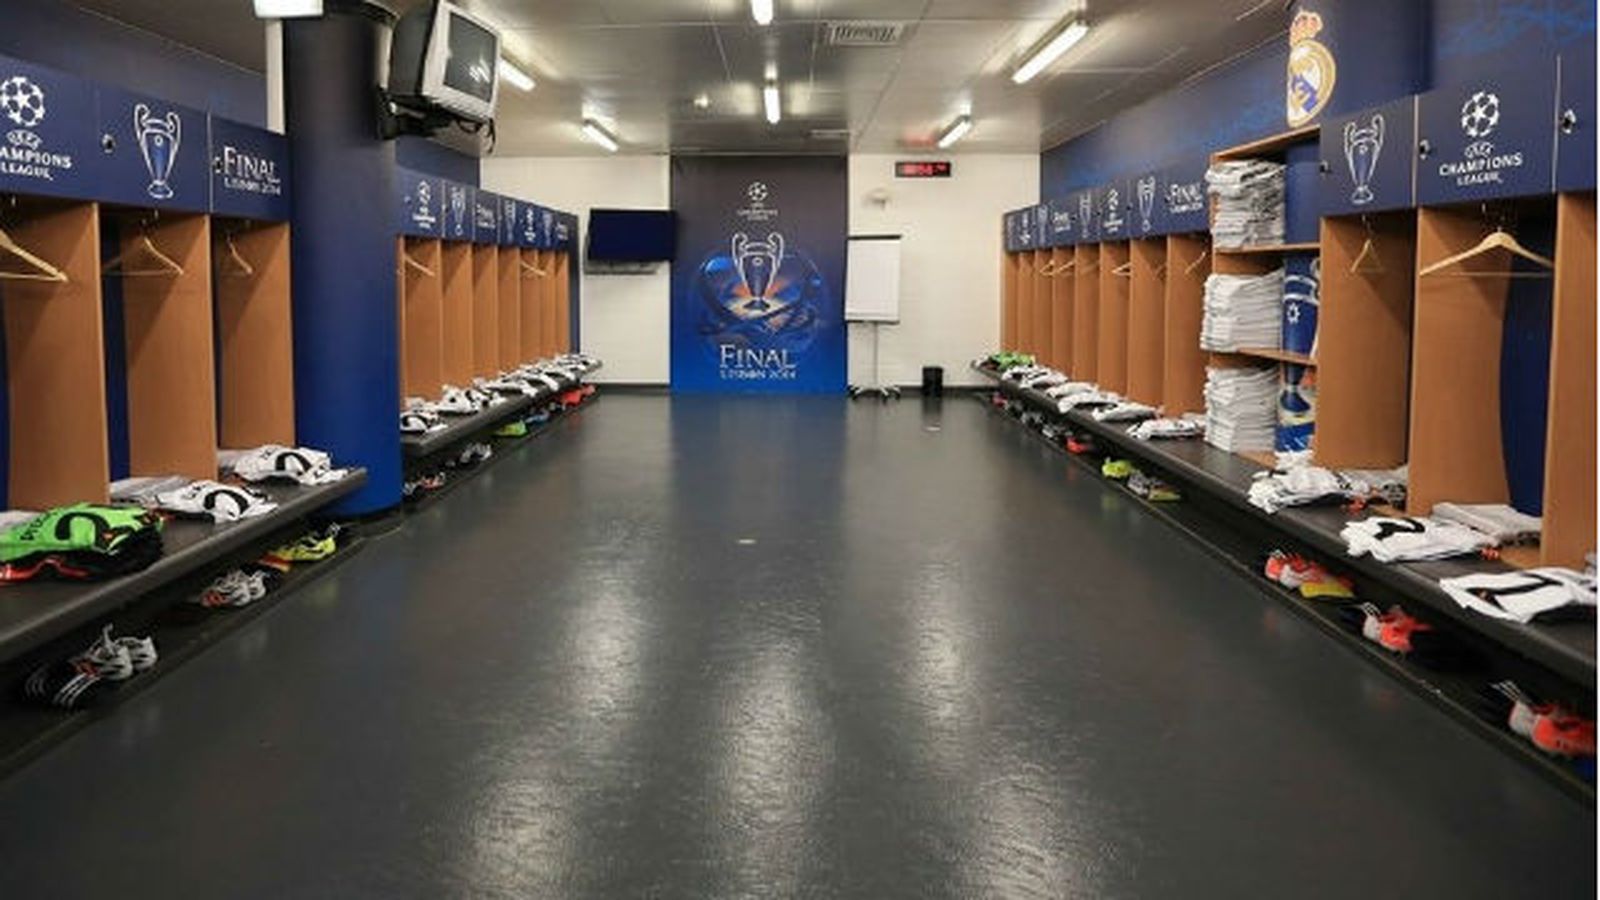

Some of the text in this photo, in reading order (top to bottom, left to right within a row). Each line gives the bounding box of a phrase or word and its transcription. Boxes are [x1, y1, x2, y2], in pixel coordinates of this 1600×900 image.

[1, 162, 52, 178] LEAGUE
[224, 146, 280, 182] FINAL
[1439, 152, 1523, 176] CHAMPIONS
[720, 344, 797, 368] FINAL
